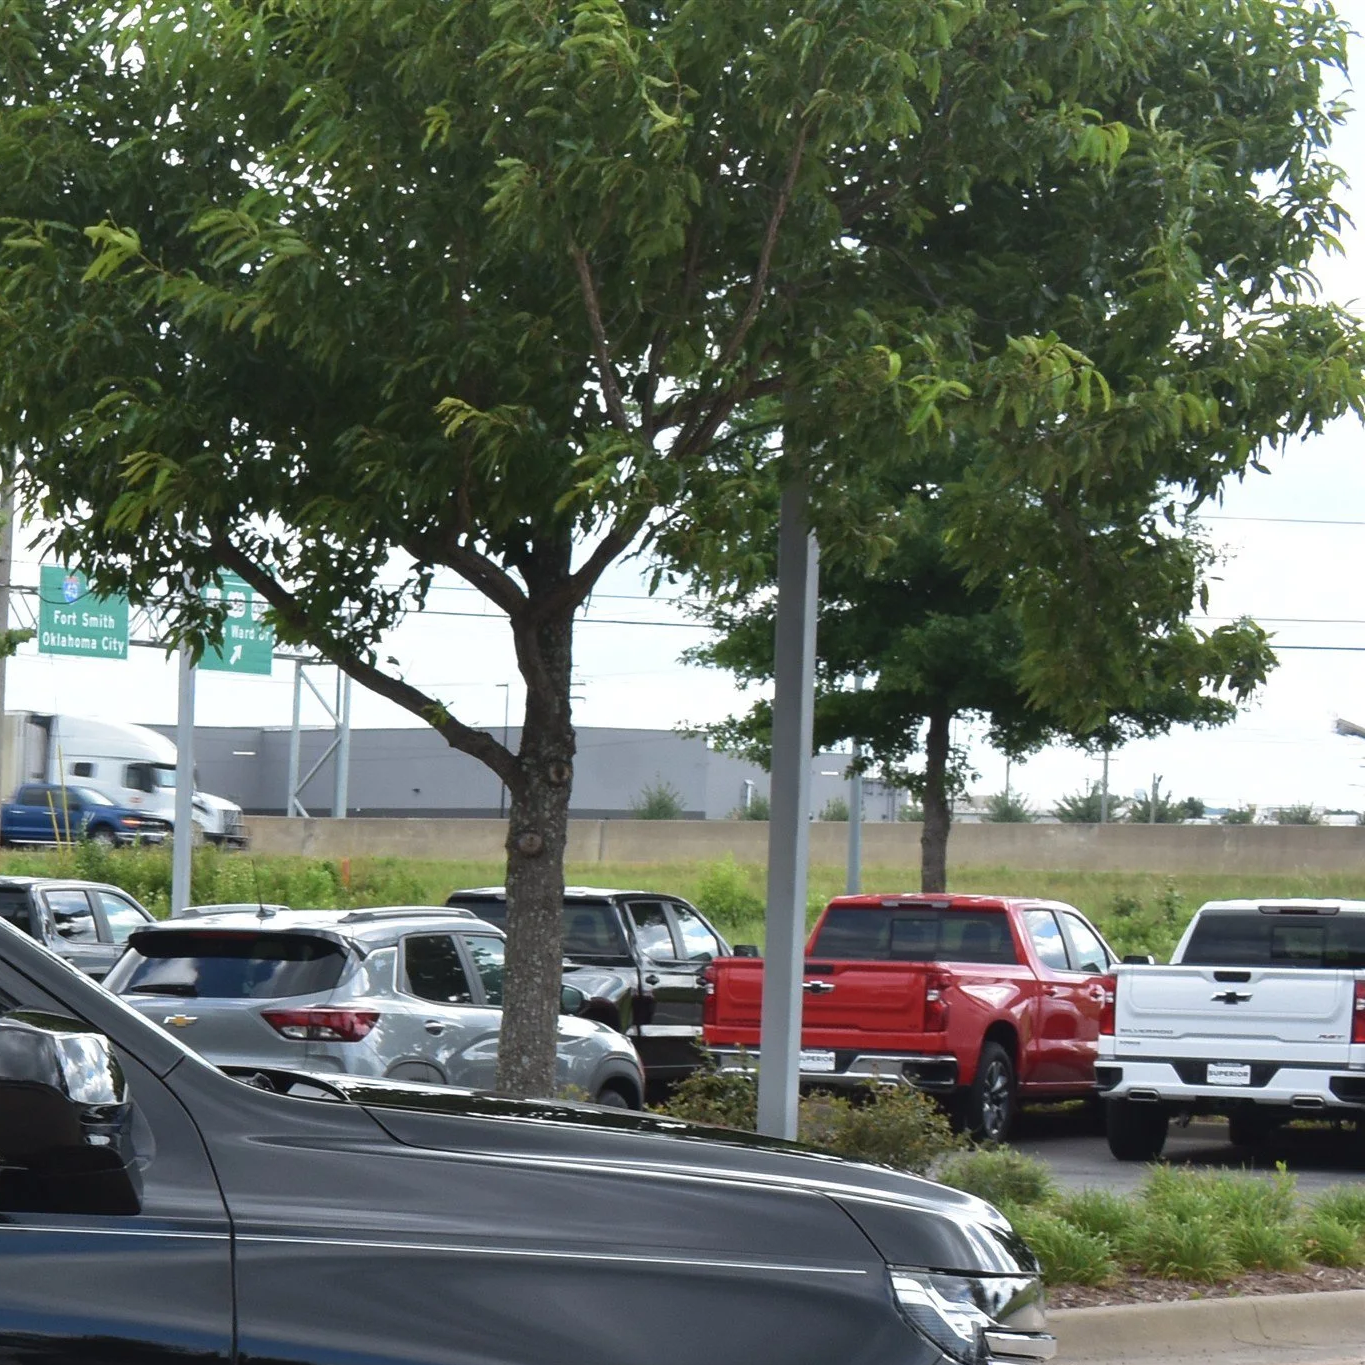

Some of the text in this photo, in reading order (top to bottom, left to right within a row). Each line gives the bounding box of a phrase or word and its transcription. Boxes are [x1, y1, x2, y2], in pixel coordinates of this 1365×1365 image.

[53, 610, 115, 628] Fort Smith
[42, 632, 125, 655] Oklahoma City
